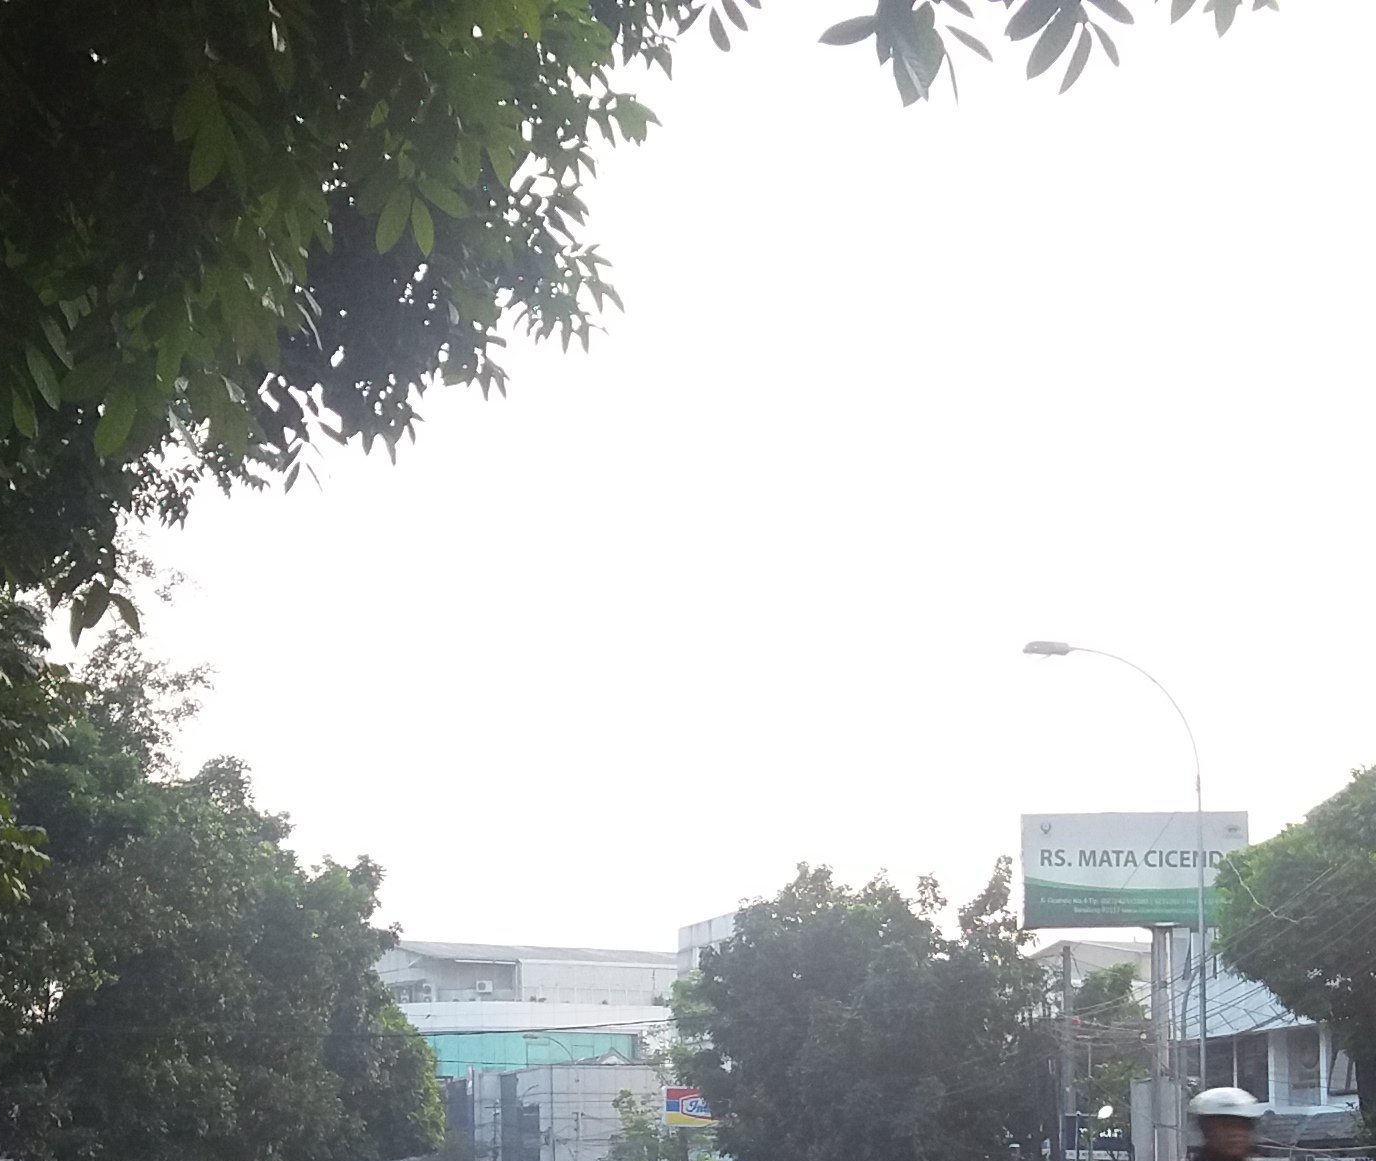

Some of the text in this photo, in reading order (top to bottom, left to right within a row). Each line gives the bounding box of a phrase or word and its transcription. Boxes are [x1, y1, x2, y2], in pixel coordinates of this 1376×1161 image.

[1040, 849, 1225, 868] RS. MATA CICEND
